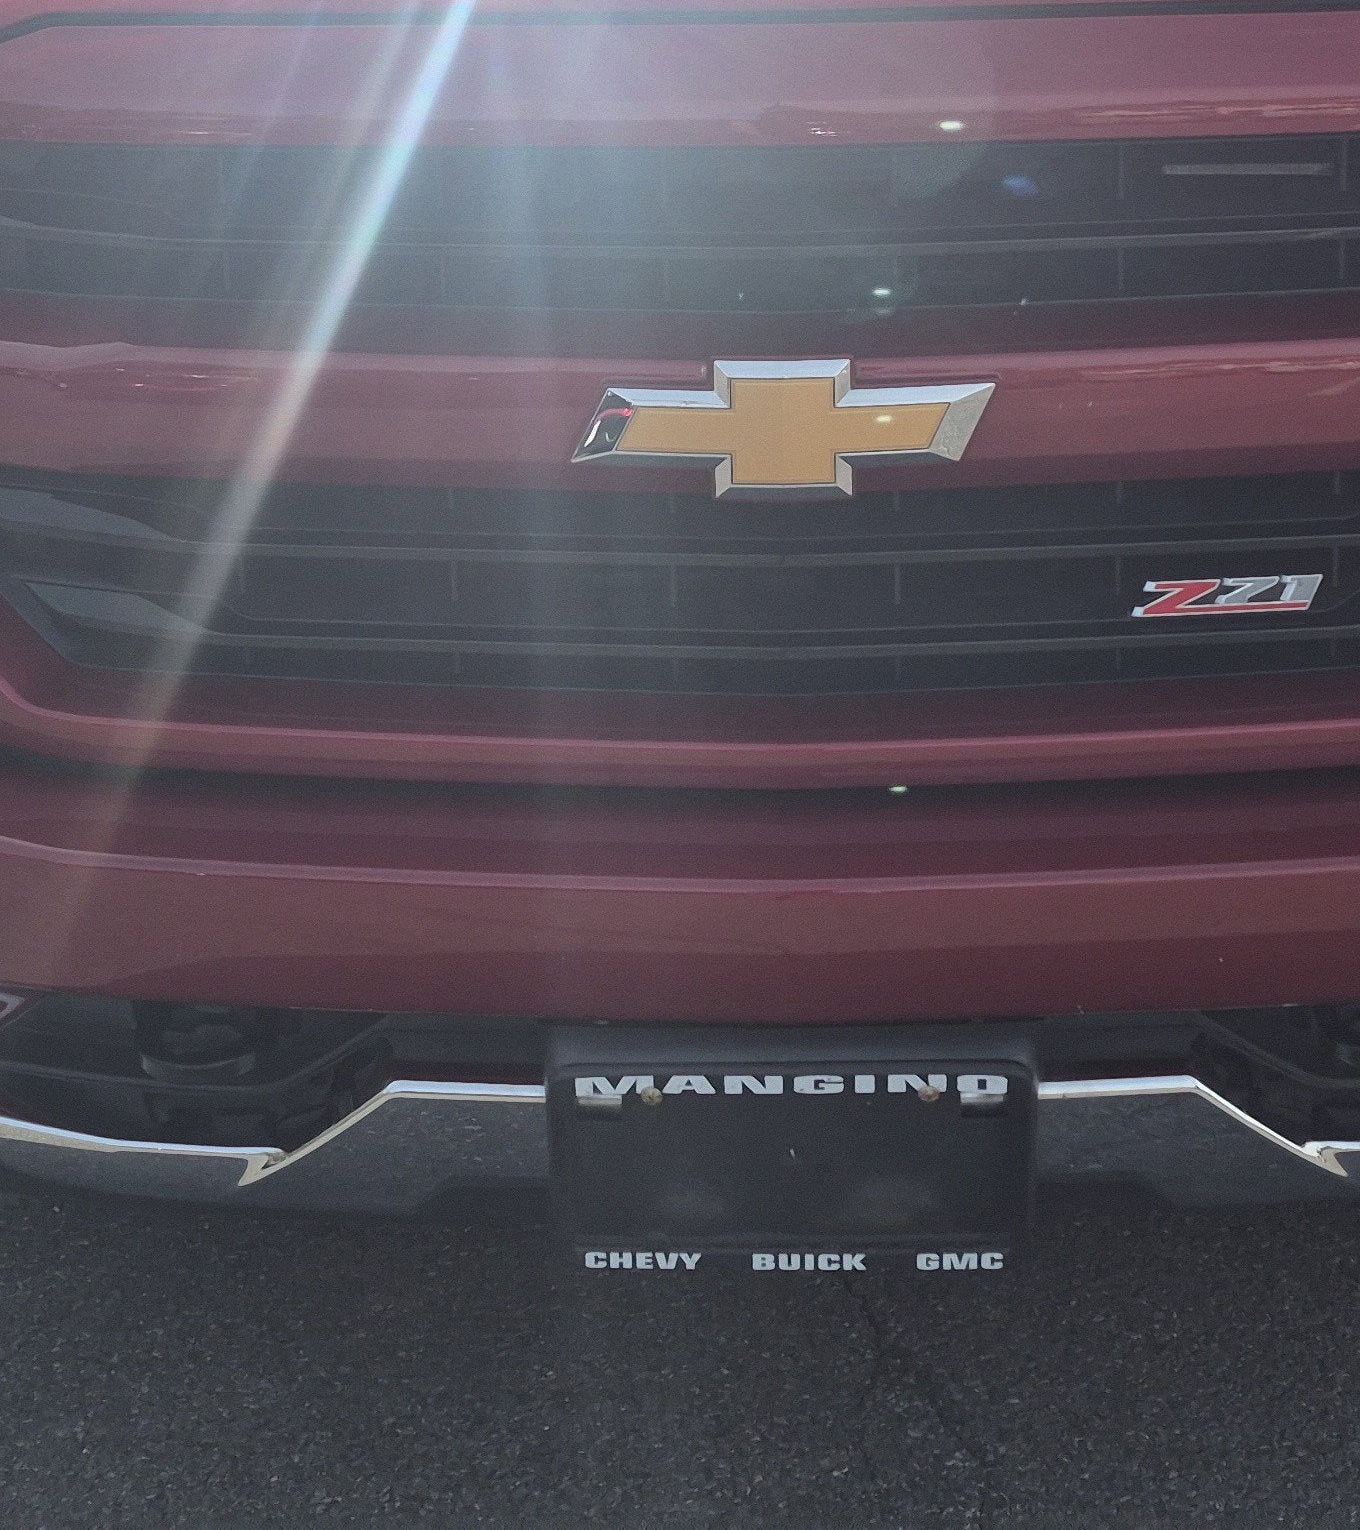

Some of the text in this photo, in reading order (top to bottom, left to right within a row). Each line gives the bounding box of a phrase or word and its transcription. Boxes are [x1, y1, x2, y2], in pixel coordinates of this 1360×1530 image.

[1130, 573, 1324, 618] Z71
[574, 1074, 1009, 1096] MANGINO
[584, 1251, 1005, 1272] CHEVY BUICK GMC
